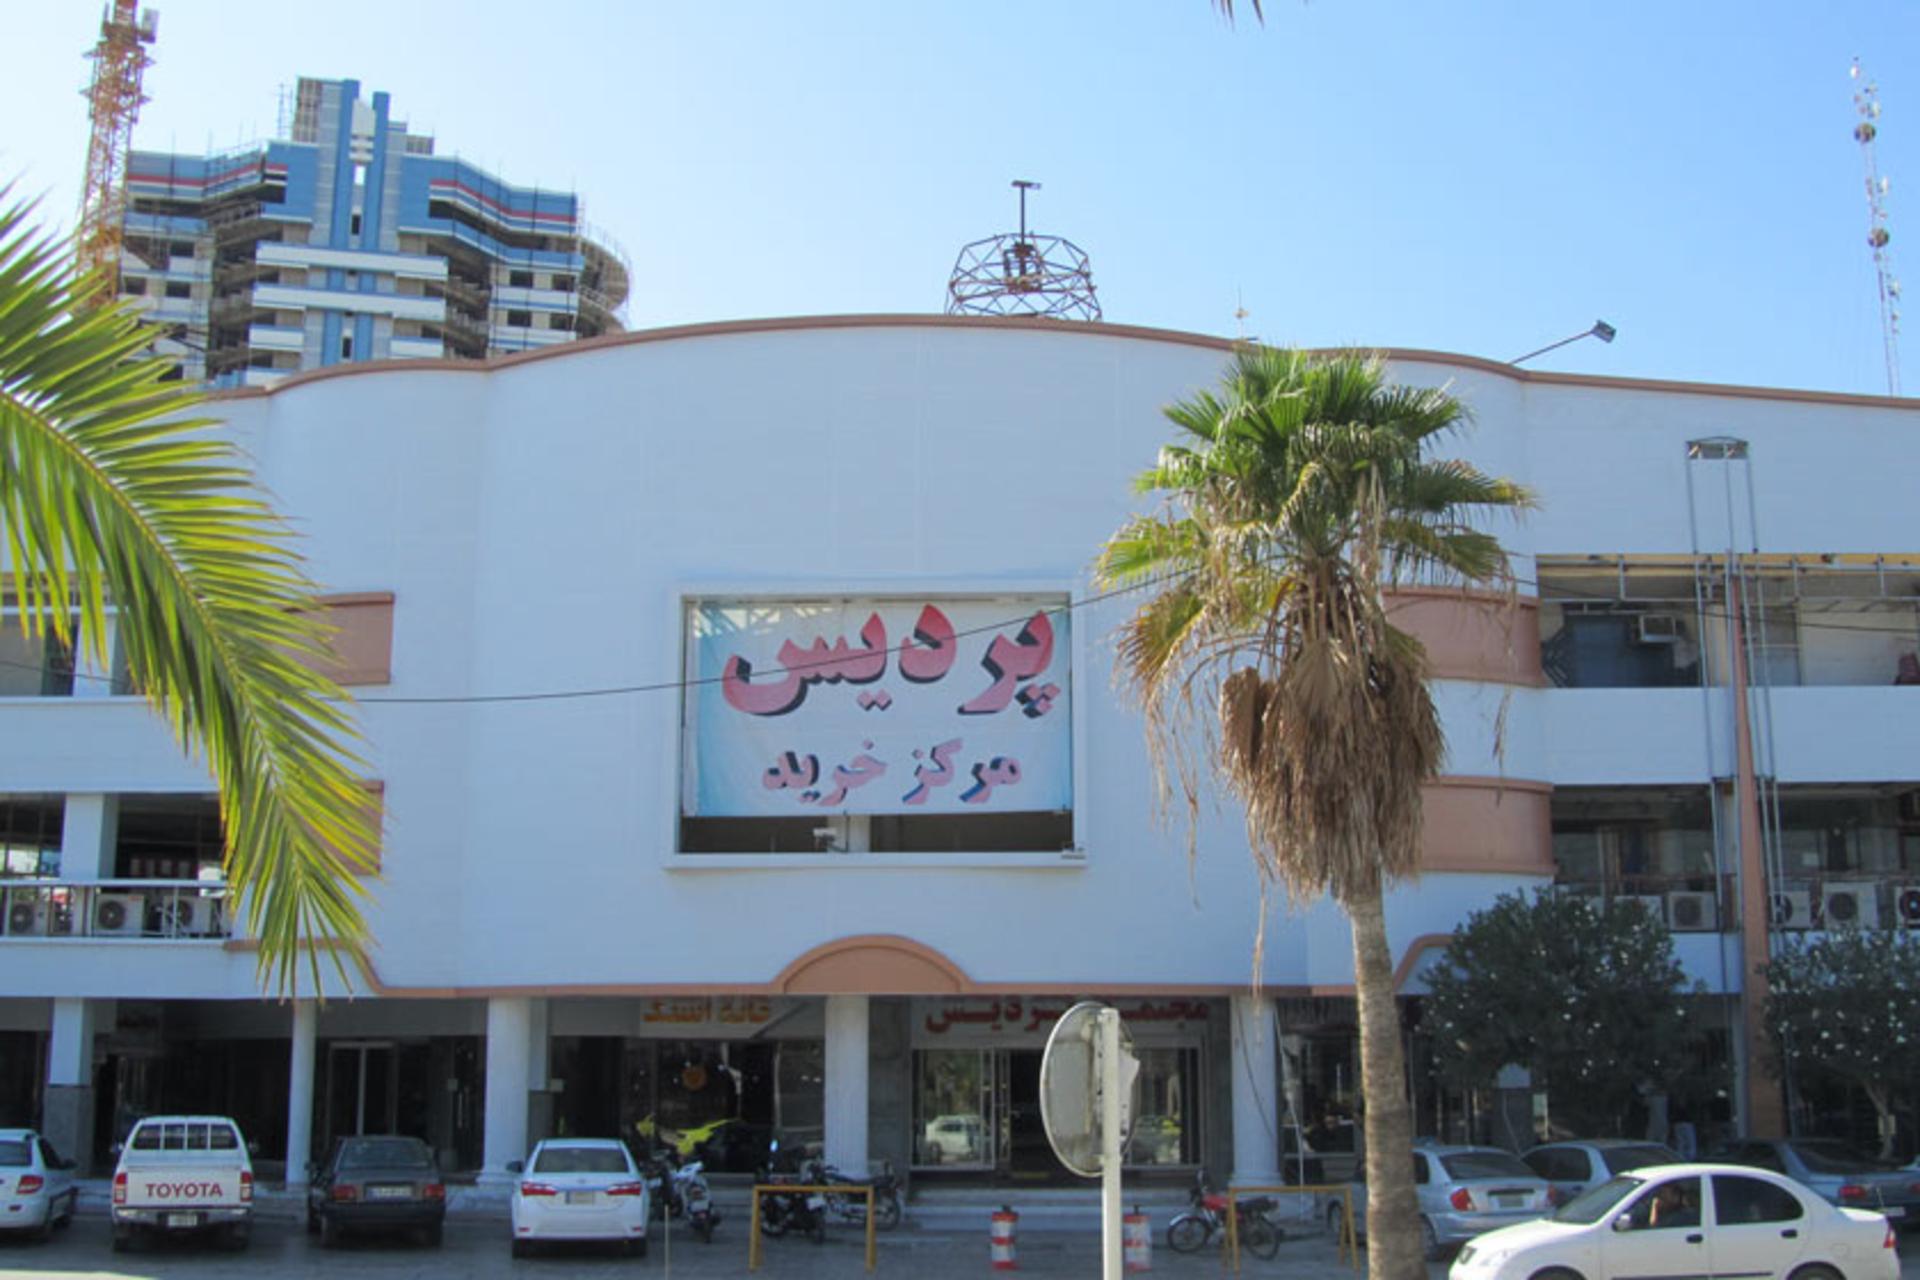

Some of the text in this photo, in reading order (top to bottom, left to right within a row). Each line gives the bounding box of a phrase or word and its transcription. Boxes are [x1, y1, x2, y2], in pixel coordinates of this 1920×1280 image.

[722, 603, 1061, 718] پردیس
[762, 738, 1022, 807] مرکز خرید
[145, 1182, 223, 1199] TOYOTA
